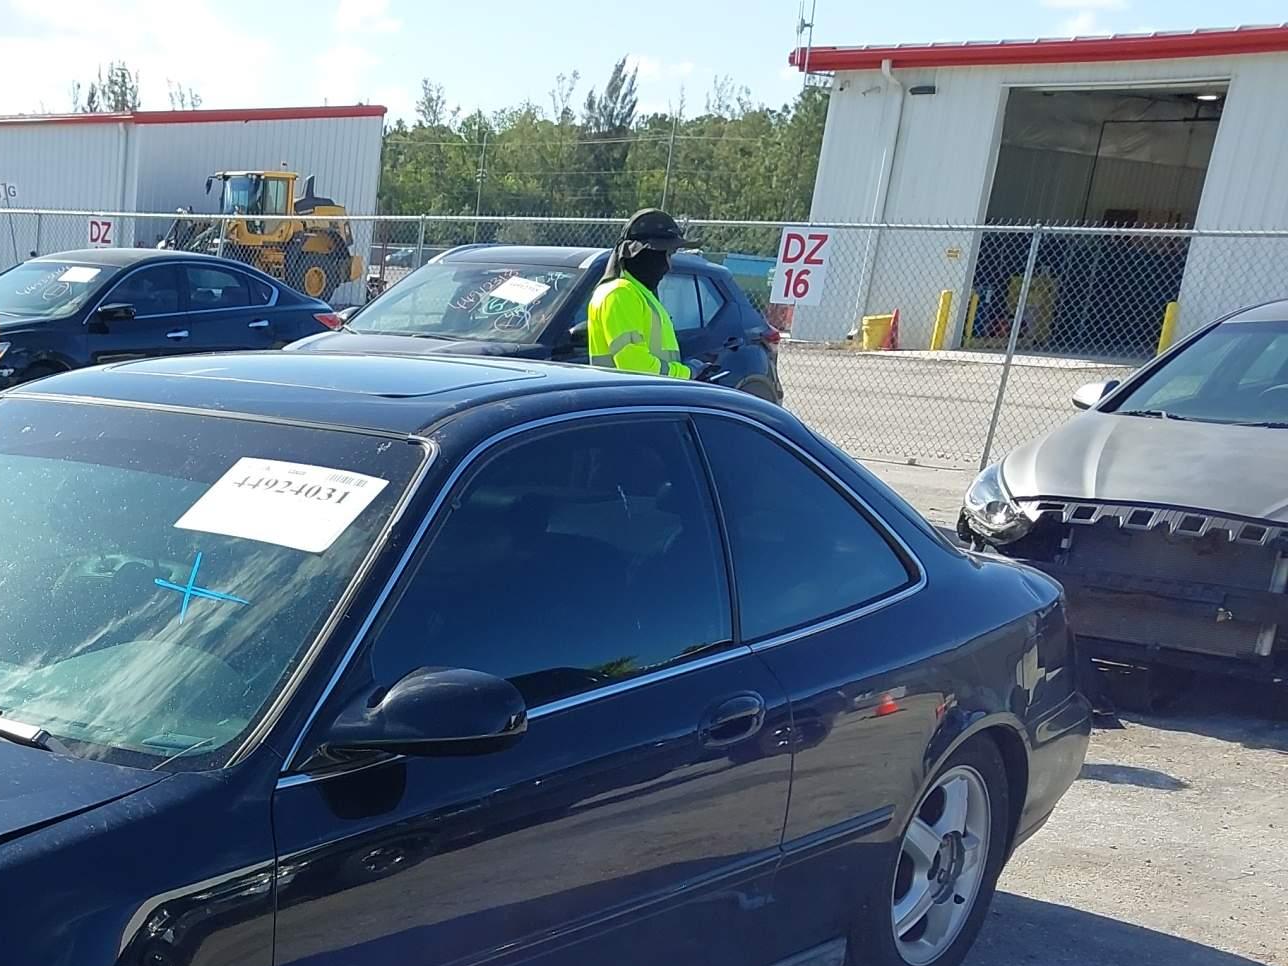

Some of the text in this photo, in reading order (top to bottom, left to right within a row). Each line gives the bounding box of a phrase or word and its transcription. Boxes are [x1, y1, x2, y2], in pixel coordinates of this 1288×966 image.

[7, 185, 17, 198] G
[90, 220, 112, 244] DZ
[782, 232, 829, 265] DZ
[783, 267, 812, 299] 16
[232, 475, 351, 504] 44924031
